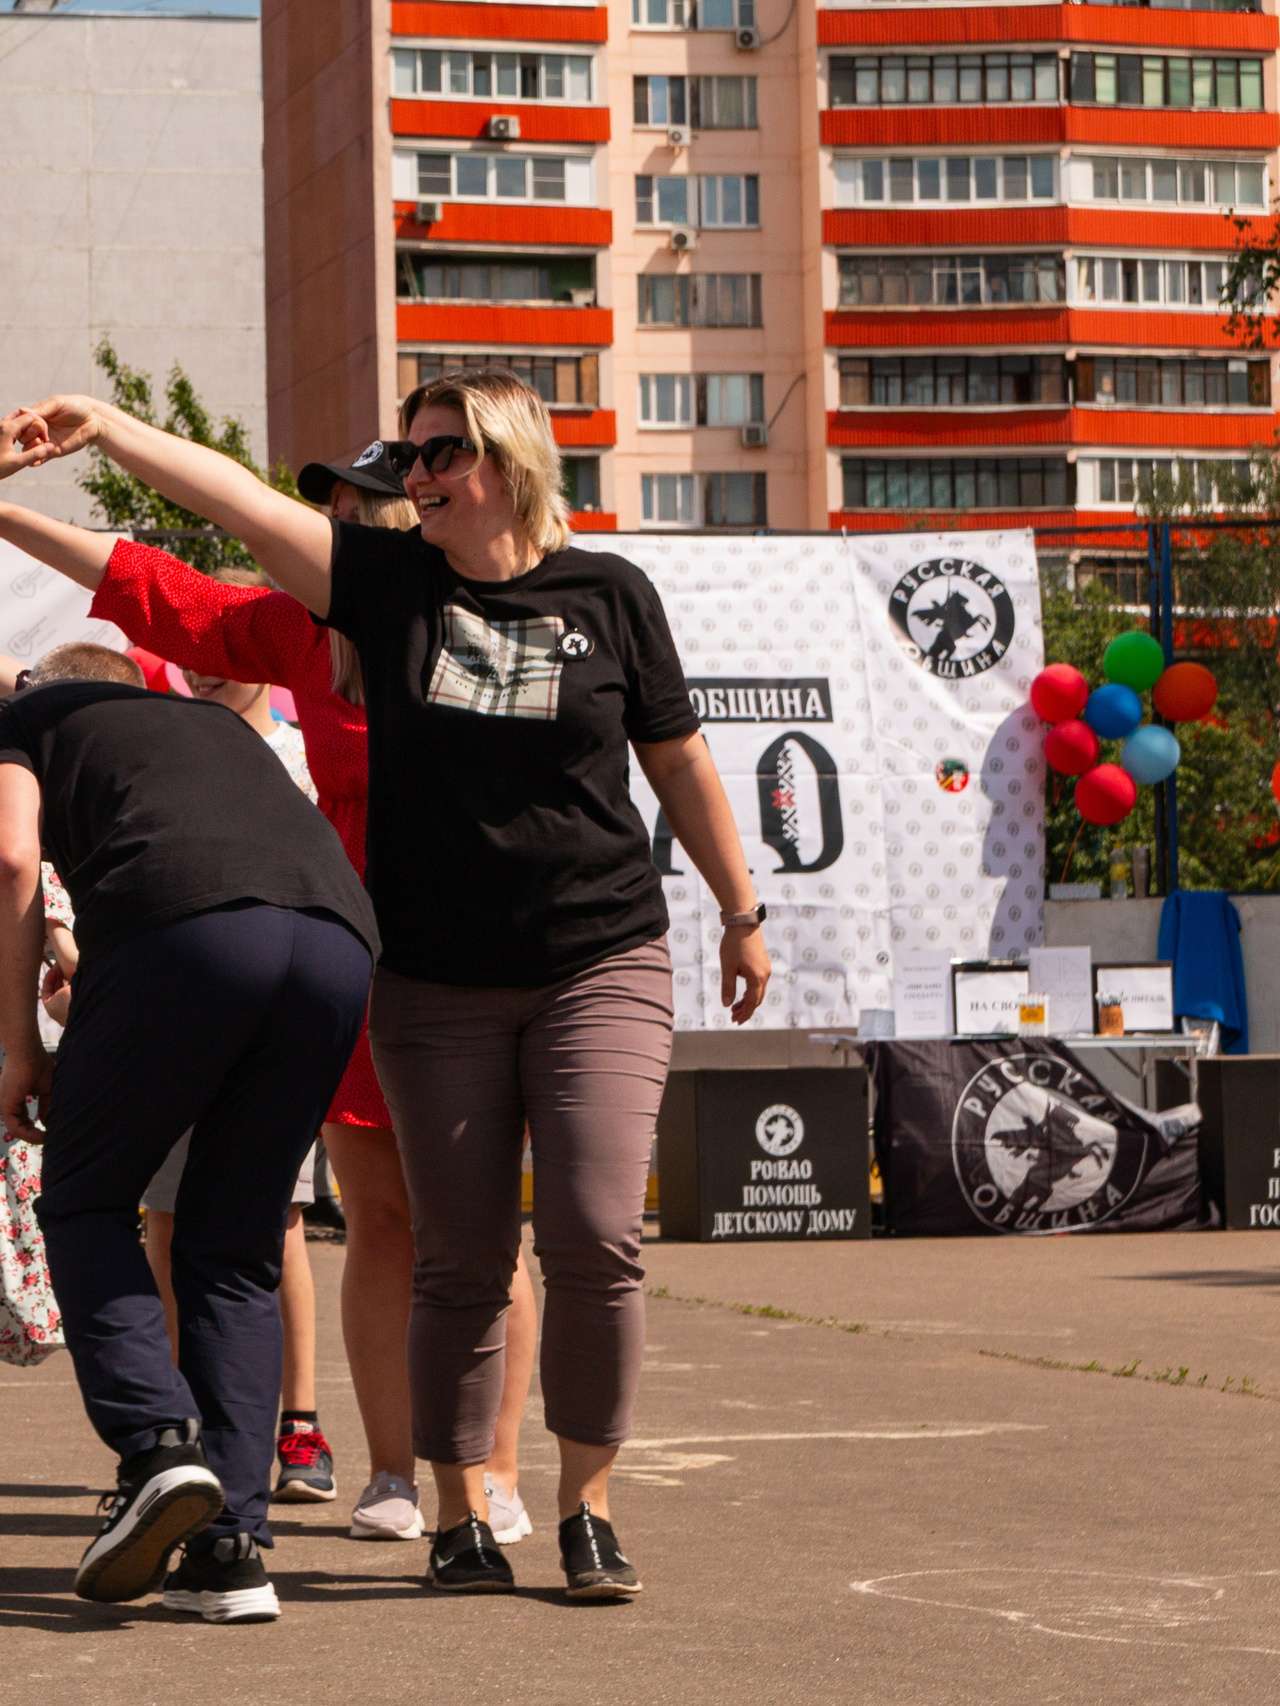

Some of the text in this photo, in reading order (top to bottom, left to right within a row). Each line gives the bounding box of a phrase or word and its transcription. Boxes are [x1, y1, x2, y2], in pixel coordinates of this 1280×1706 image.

[893, 558, 1005, 603] РУССКАЯ
[902, 639, 1006, 678] ОБЩИНА
[689, 687, 827, 722] ОБЩИНА
[970, 1001, 987, 1012] НА
[742, 1184, 822, 1208] ПОМОЩЬ
[972, 1182, 1124, 1230] ОБЩИНА
[712, 1208, 857, 1239] ДЕТСКОМУ ДОМУ
